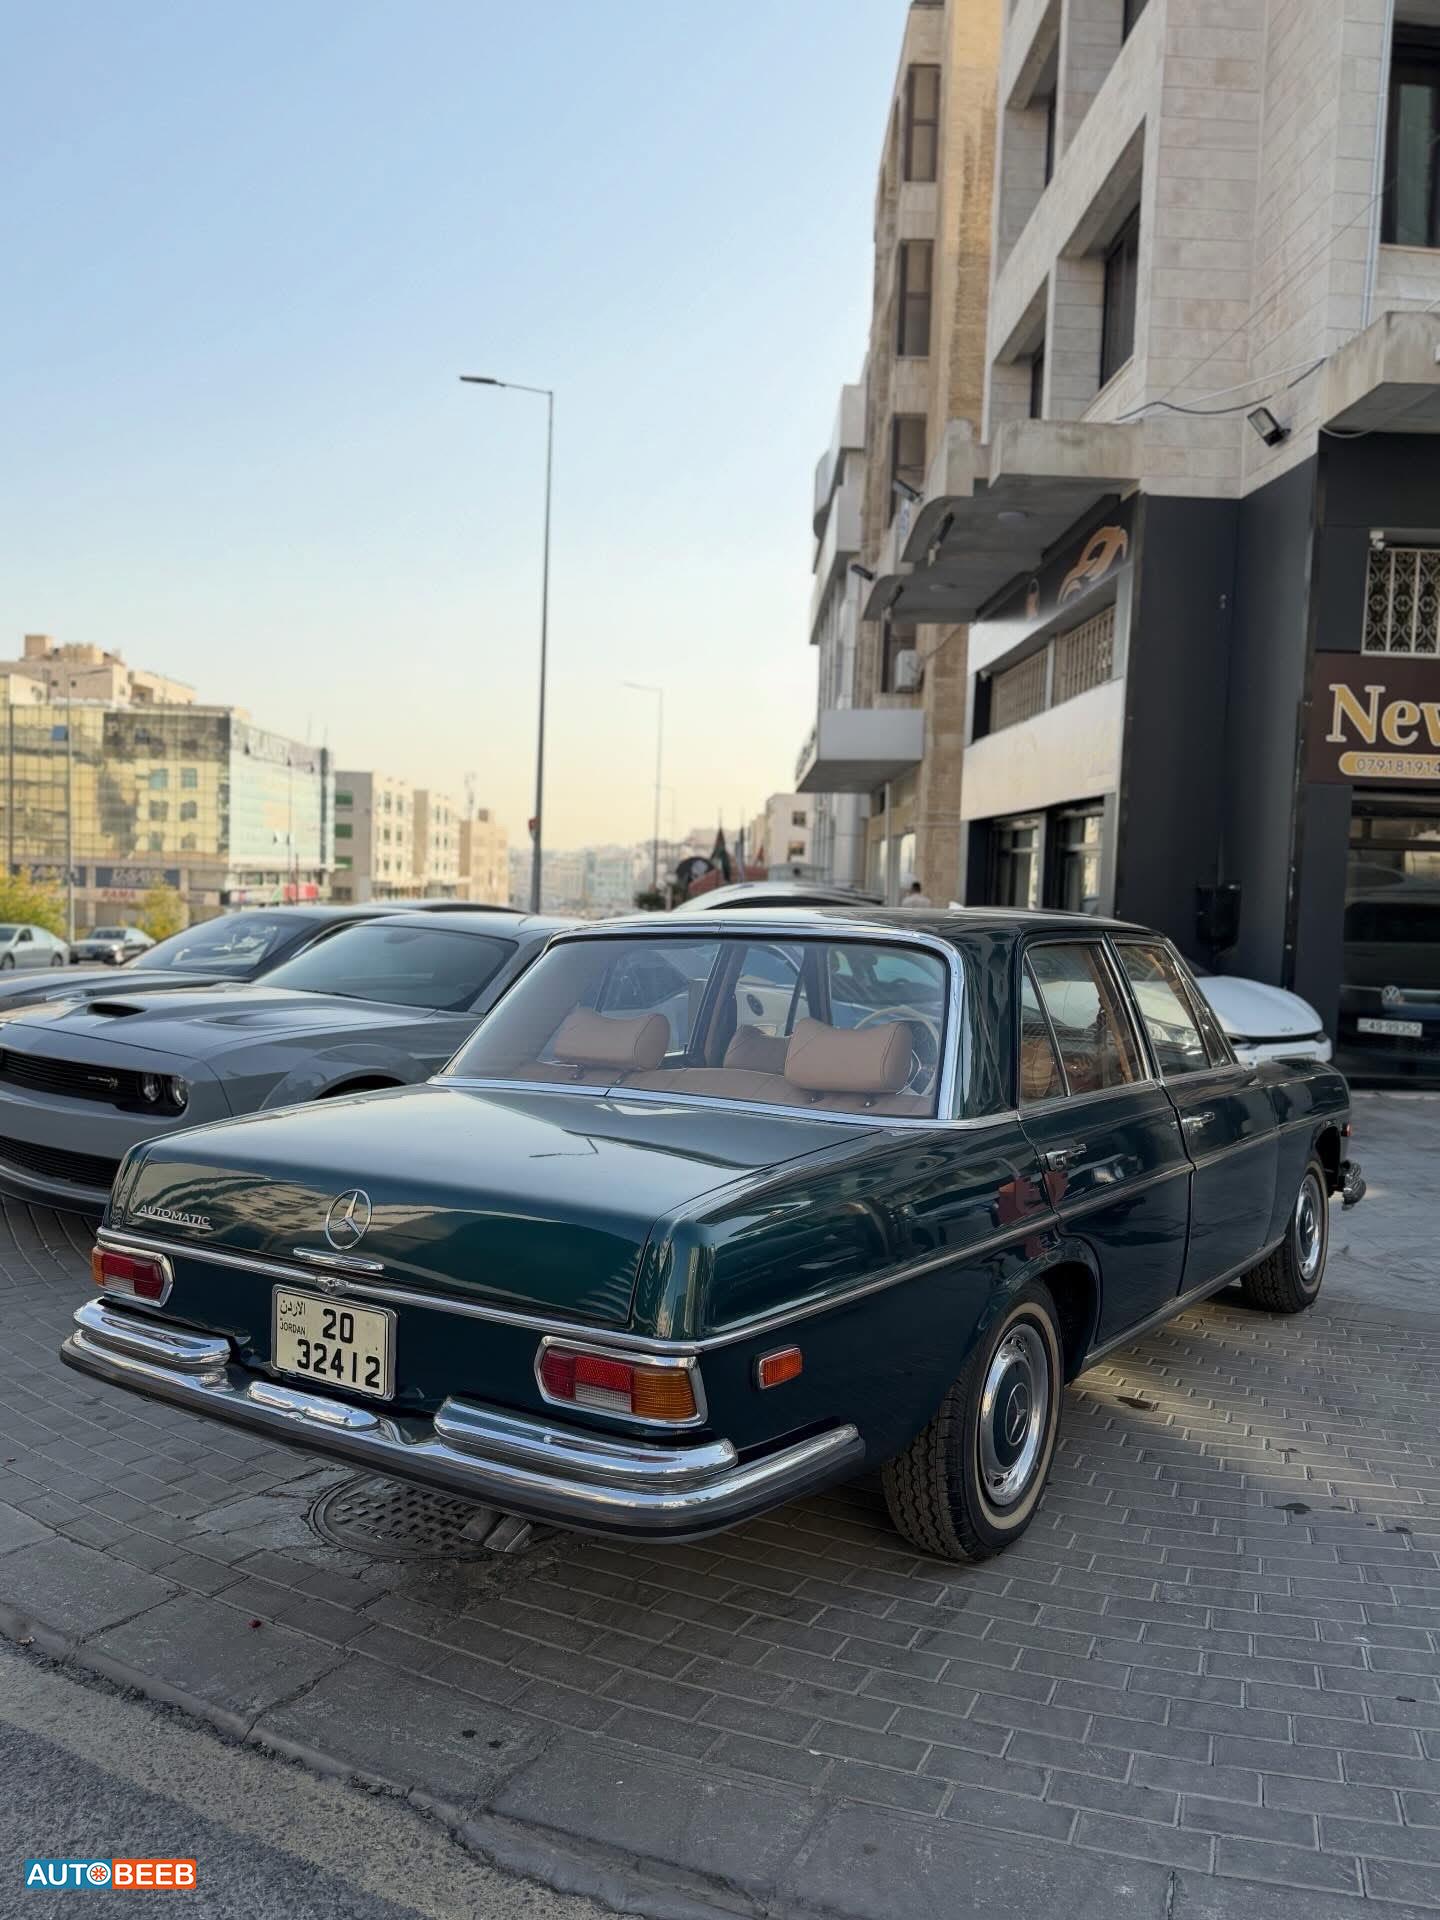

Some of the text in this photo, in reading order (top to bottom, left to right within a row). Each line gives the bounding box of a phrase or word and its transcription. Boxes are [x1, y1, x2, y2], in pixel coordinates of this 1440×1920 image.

[140, 1204, 211, 1225] AUTOMATIC
[280, 1322, 306, 1336] JORDAN
[322, 1308, 354, 1344] 20
[296, 1338, 380, 1389] 32412
